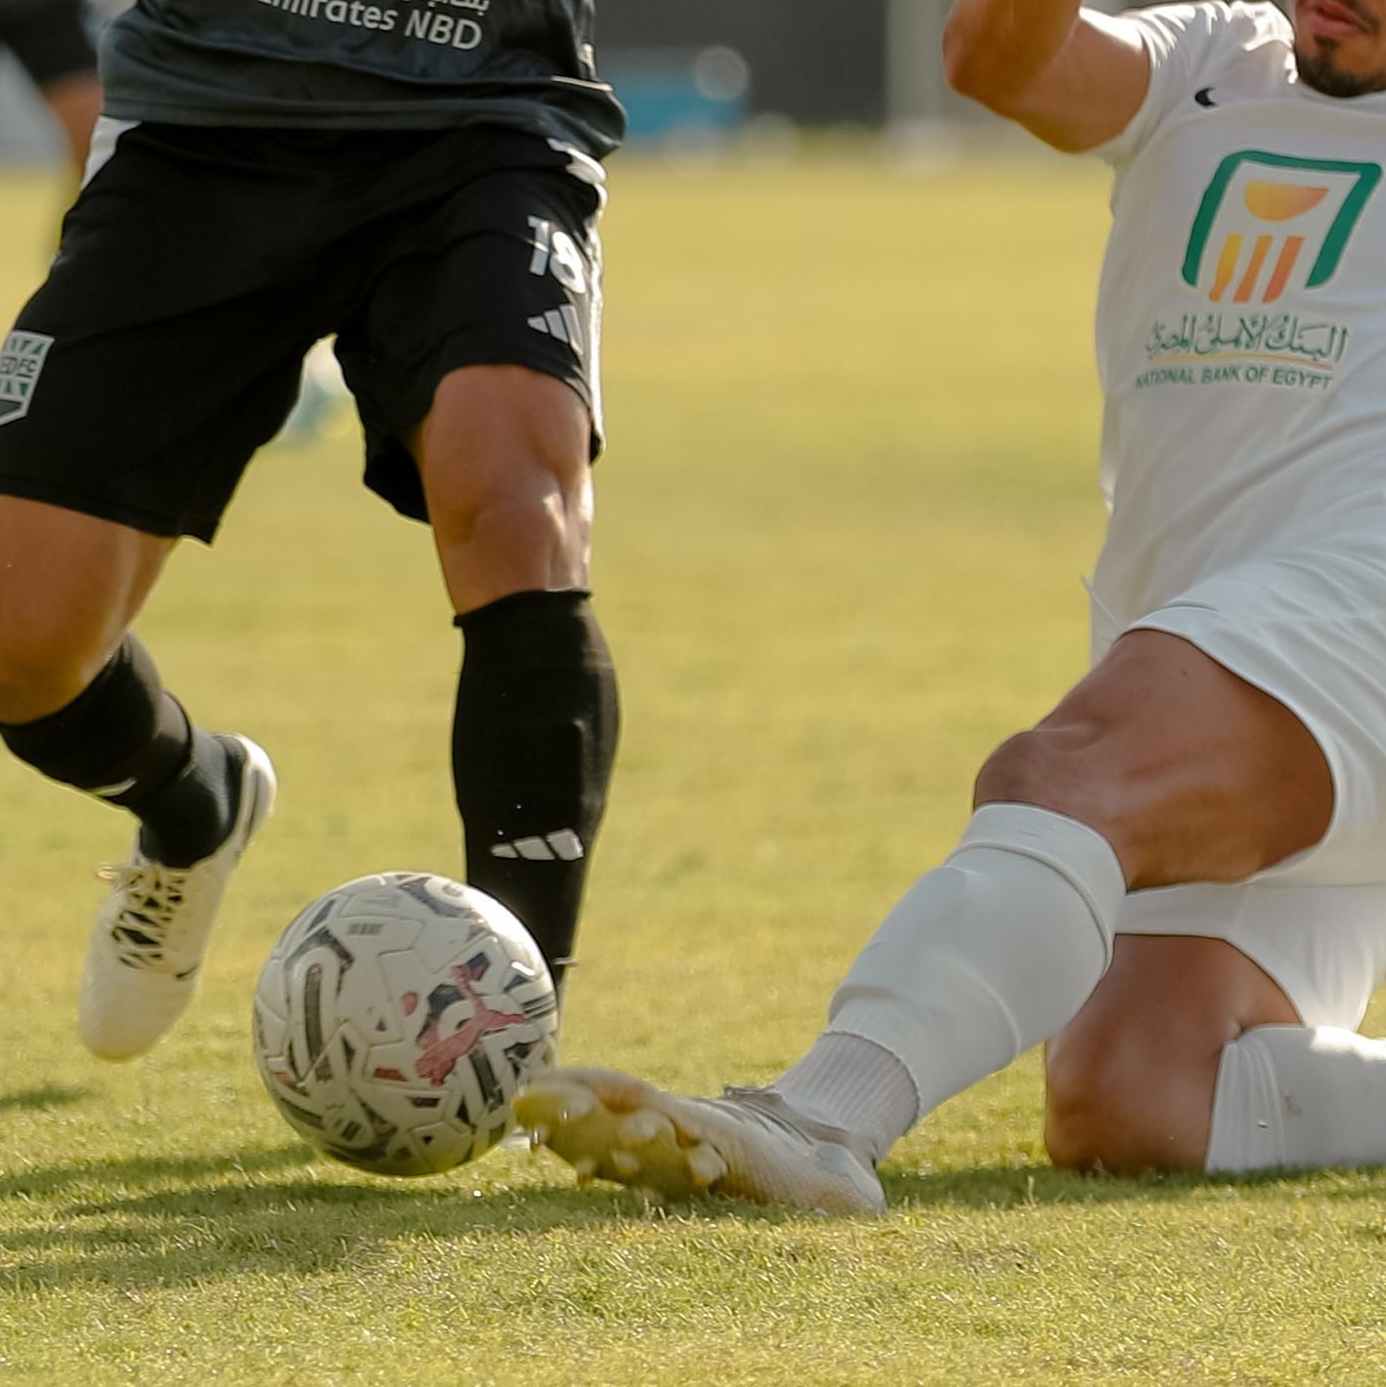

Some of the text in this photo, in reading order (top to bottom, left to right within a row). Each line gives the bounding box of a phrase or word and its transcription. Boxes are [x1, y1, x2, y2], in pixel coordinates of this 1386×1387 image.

[404, 9, 483, 51] NBD
[1135, 365, 1335, 391] NATIONAL BANK OF EGYPT
